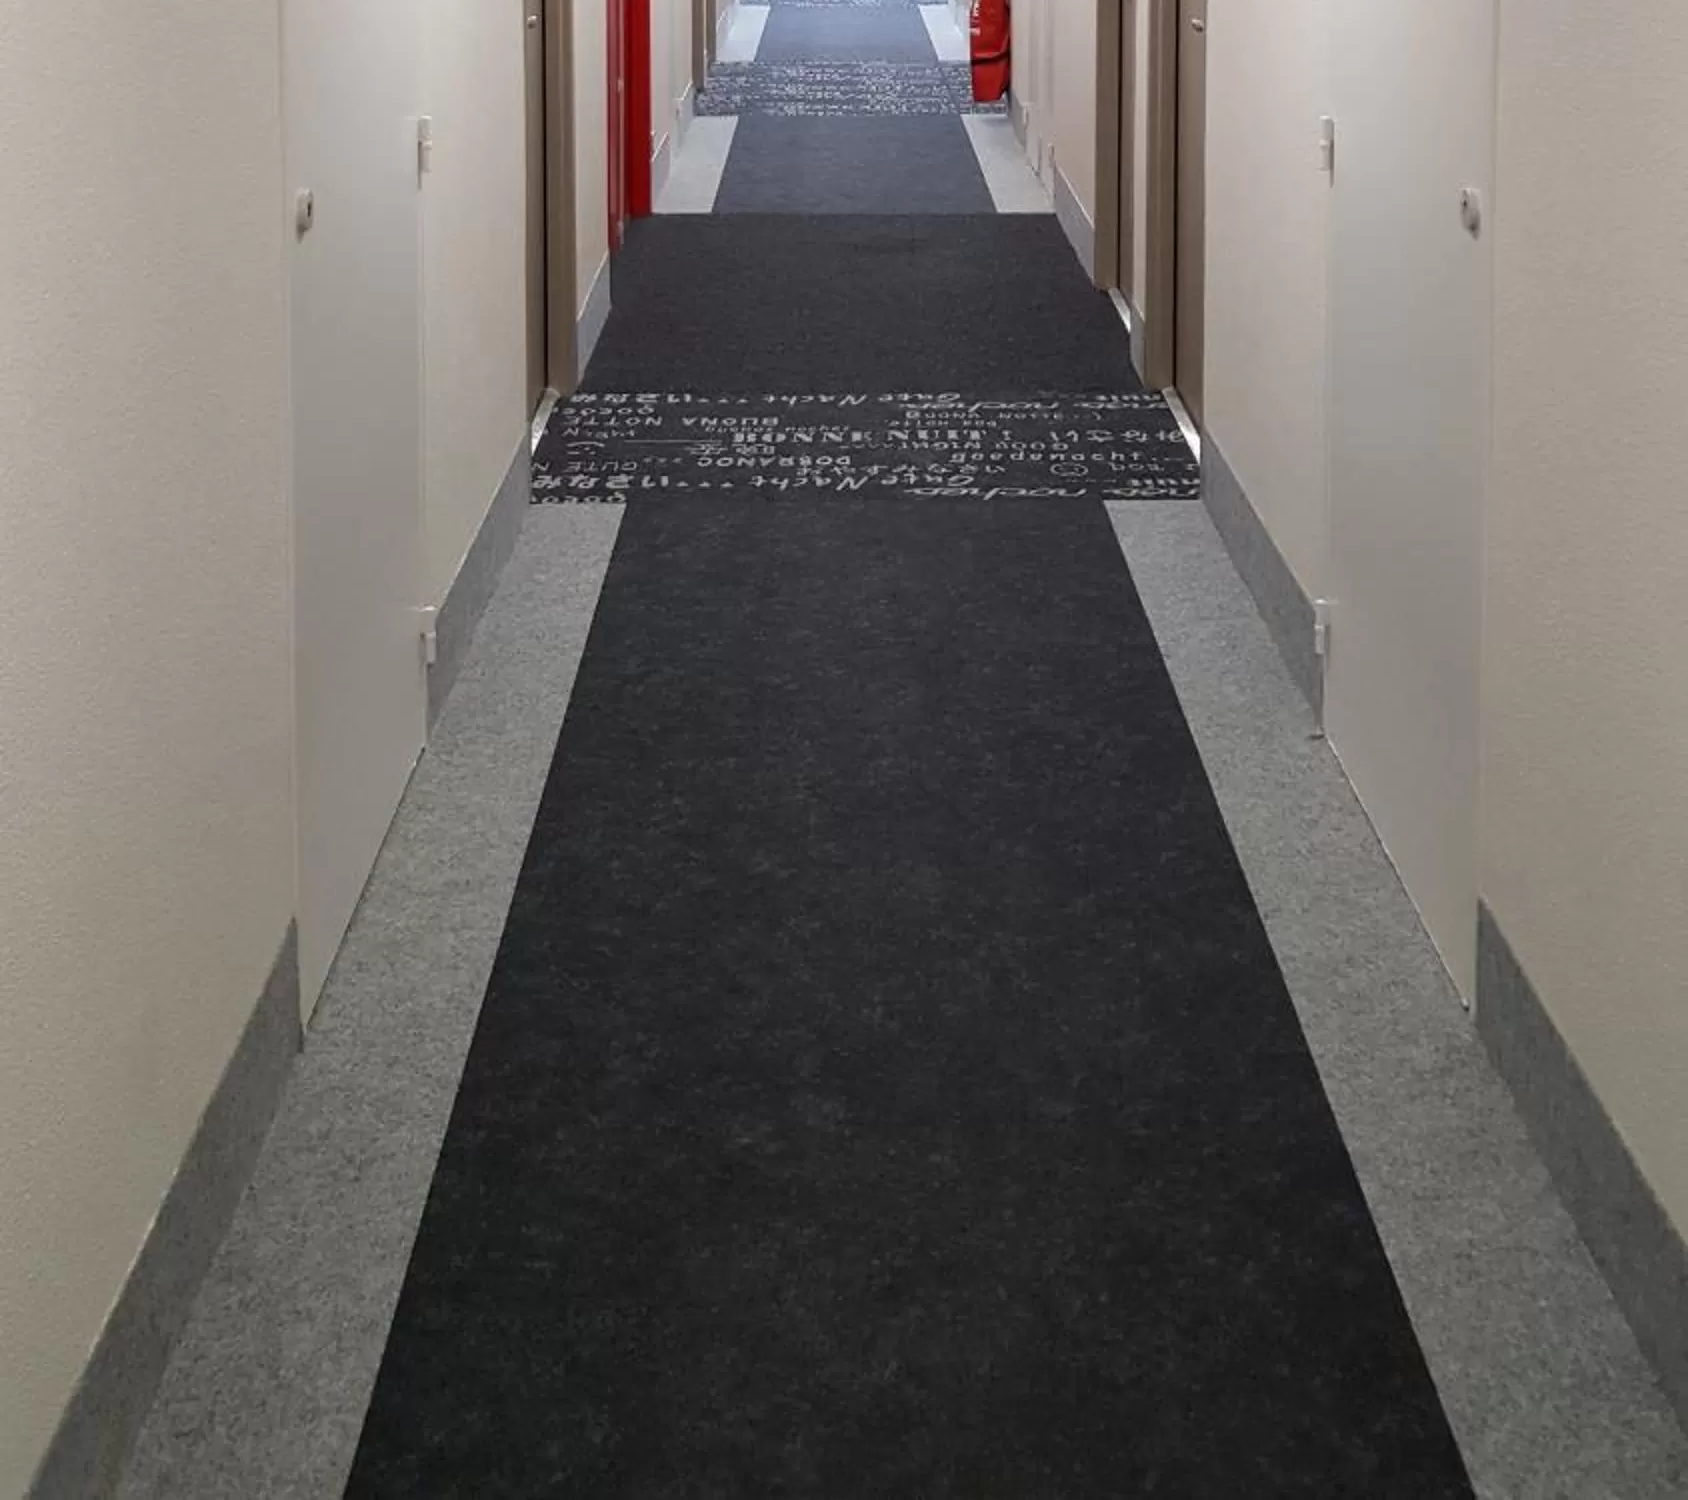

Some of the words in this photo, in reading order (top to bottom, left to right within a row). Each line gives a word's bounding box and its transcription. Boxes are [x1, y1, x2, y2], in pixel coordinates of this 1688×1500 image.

[563, 416, 664, 426] NOTTE
[682, 416, 780, 426] BUONA
[731, 431, 873, 442] BONNE
[885, 429, 988, 441] NUIT
[748, 474, 869, 492] Nacht
